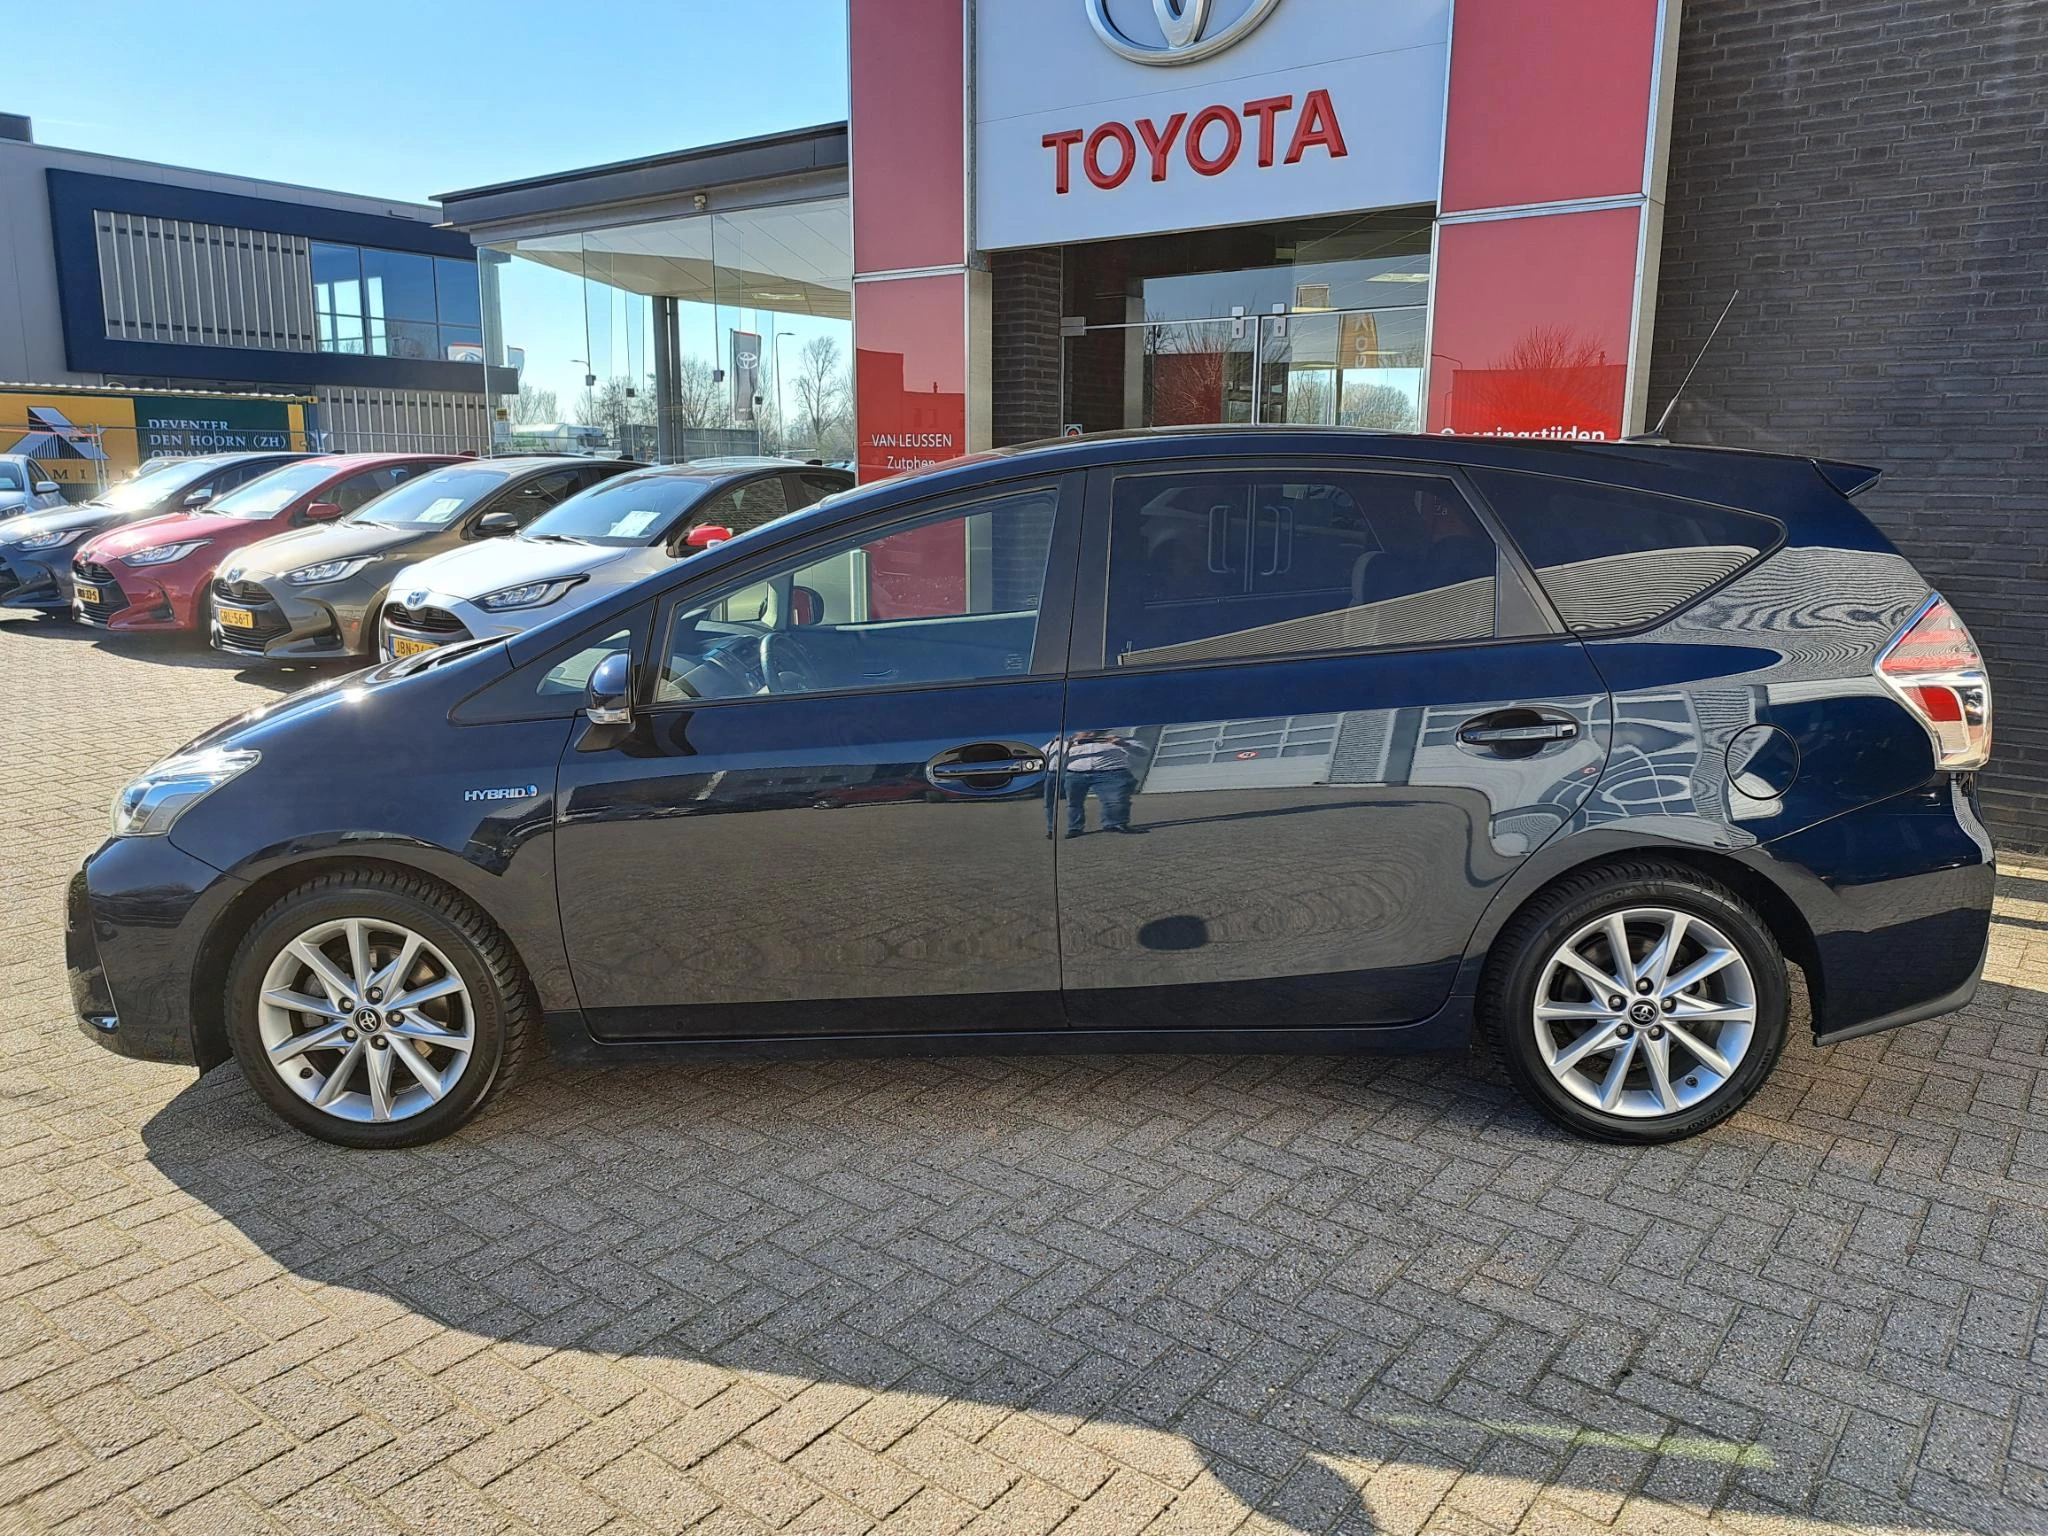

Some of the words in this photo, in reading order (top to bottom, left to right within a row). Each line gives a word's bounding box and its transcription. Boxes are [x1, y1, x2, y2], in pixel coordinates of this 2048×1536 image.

[1041, 89, 1348, 194] TOYOTA
[148, 419, 228, 430] DEVENTER
[150, 434, 182, 446] DEN
[190, 435, 246, 447] HOORN
[253, 435, 287, 448] (ZH)
[872, 434, 896, 447] VAN
[899, 434, 952, 447] LEUSSEN
[887, 456, 936, 471] Zutphen
[464, 788, 526, 801] HYBRID
